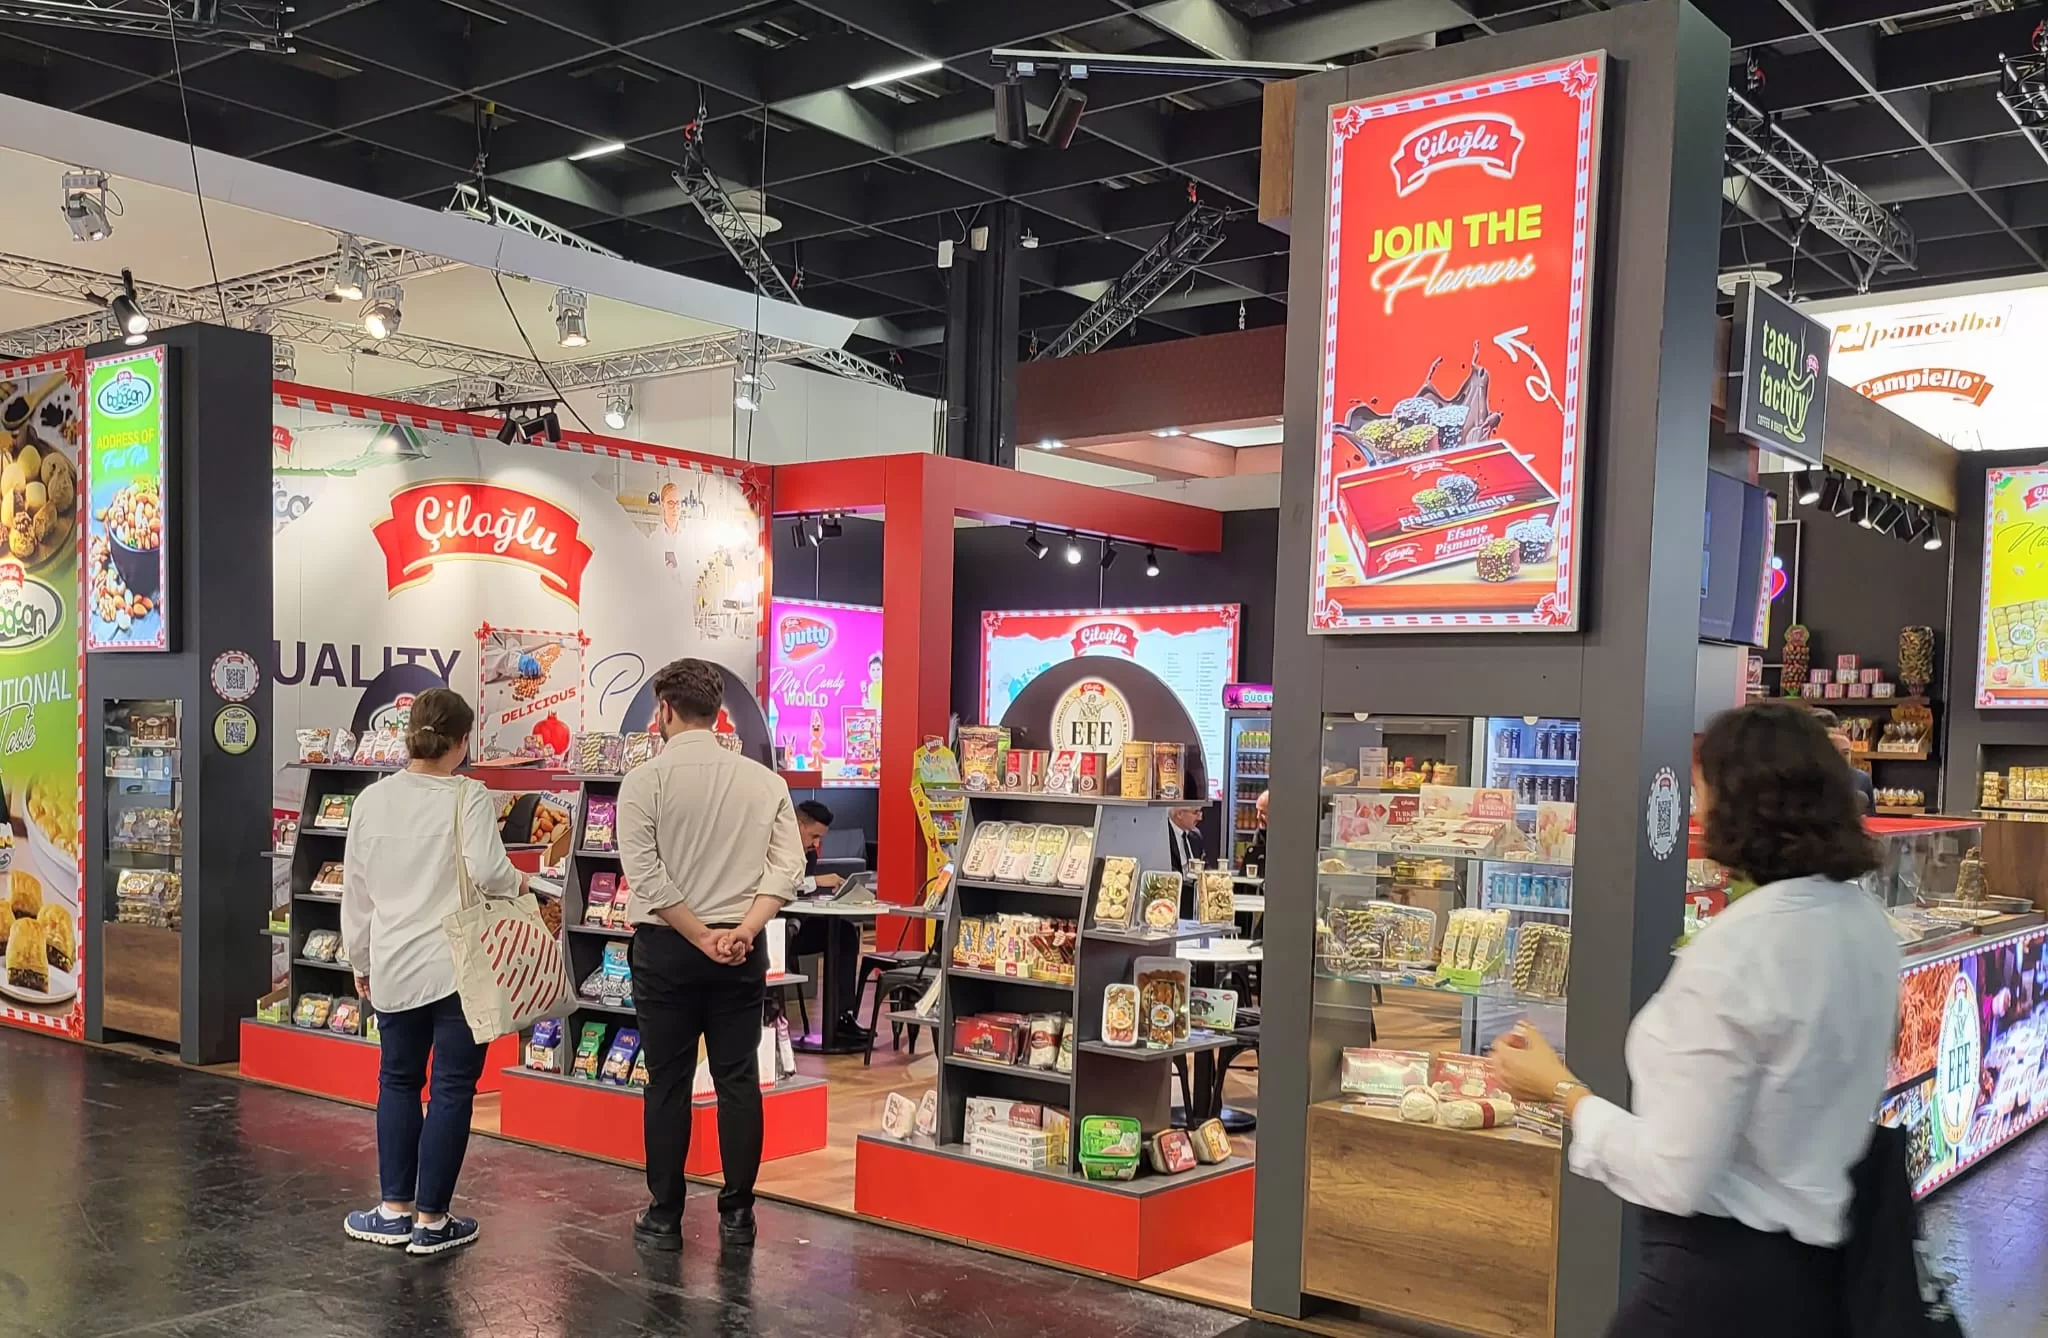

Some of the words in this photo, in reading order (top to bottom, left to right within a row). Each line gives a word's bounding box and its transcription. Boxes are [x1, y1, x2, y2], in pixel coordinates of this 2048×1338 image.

[1414, 124, 1499, 168] Çiloğlu
[1367, 219, 1453, 263] JOIN
[1462, 204, 1543, 248] THE
[1370, 246, 1536, 315] Flavours
[1762, 319, 1798, 373] tasty
[1760, 364, 1806, 430] factory
[1856, 368, 1973, 398] Campiello
[96, 431, 140, 450] ADDRESS
[141, 428, 154, 445] OF
[414, 493, 559, 557] Çiloğlu
[1400, 509, 1445, 527] Efsane
[1447, 524, 1489, 542] Efsane
[783, 625, 830, 654] yutty
[1081, 626, 1128, 648] Çiloğlu
[804, 664, 846, 697] Candy
[501, 686, 577, 725] DELICIOUS
[784, 691, 829, 708] WORLD
[1070, 721, 1113, 746] EFE
[1947, 1042, 1971, 1093] EFE
